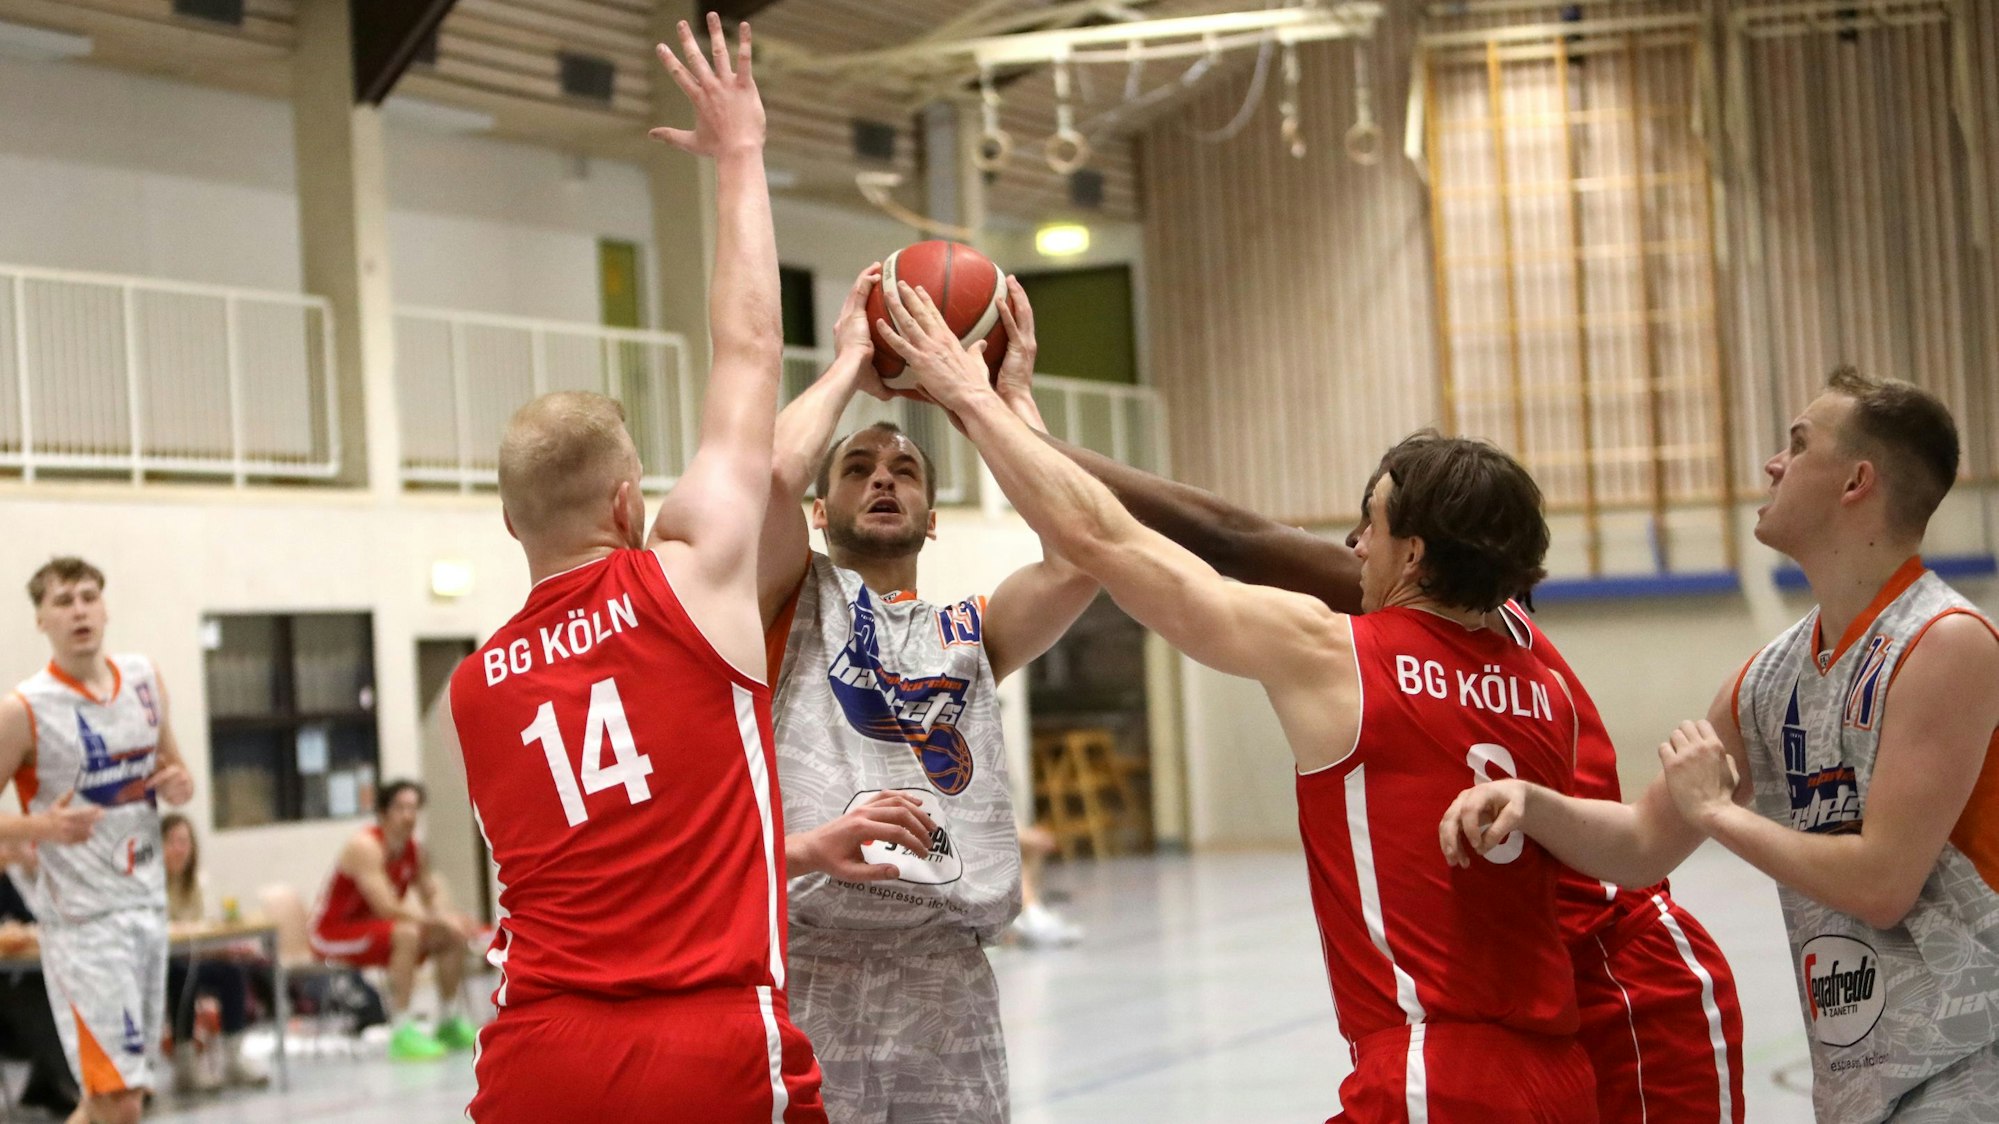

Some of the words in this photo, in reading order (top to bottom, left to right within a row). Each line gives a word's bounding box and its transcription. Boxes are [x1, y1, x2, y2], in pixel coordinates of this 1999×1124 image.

[484, 637, 532, 687] BG
[539, 592, 639, 664] KÖLN
[828, 652, 968, 734] bakets
[1396, 655, 1447, 699] BG
[1456, 664, 1553, 721] KÖLN
[520, 677, 654, 828] 14
[869, 886, 924, 906] espresso
[1804, 953, 1876, 1023] Segafredo
[1829, 1005, 1858, 1018] ZANETTI
